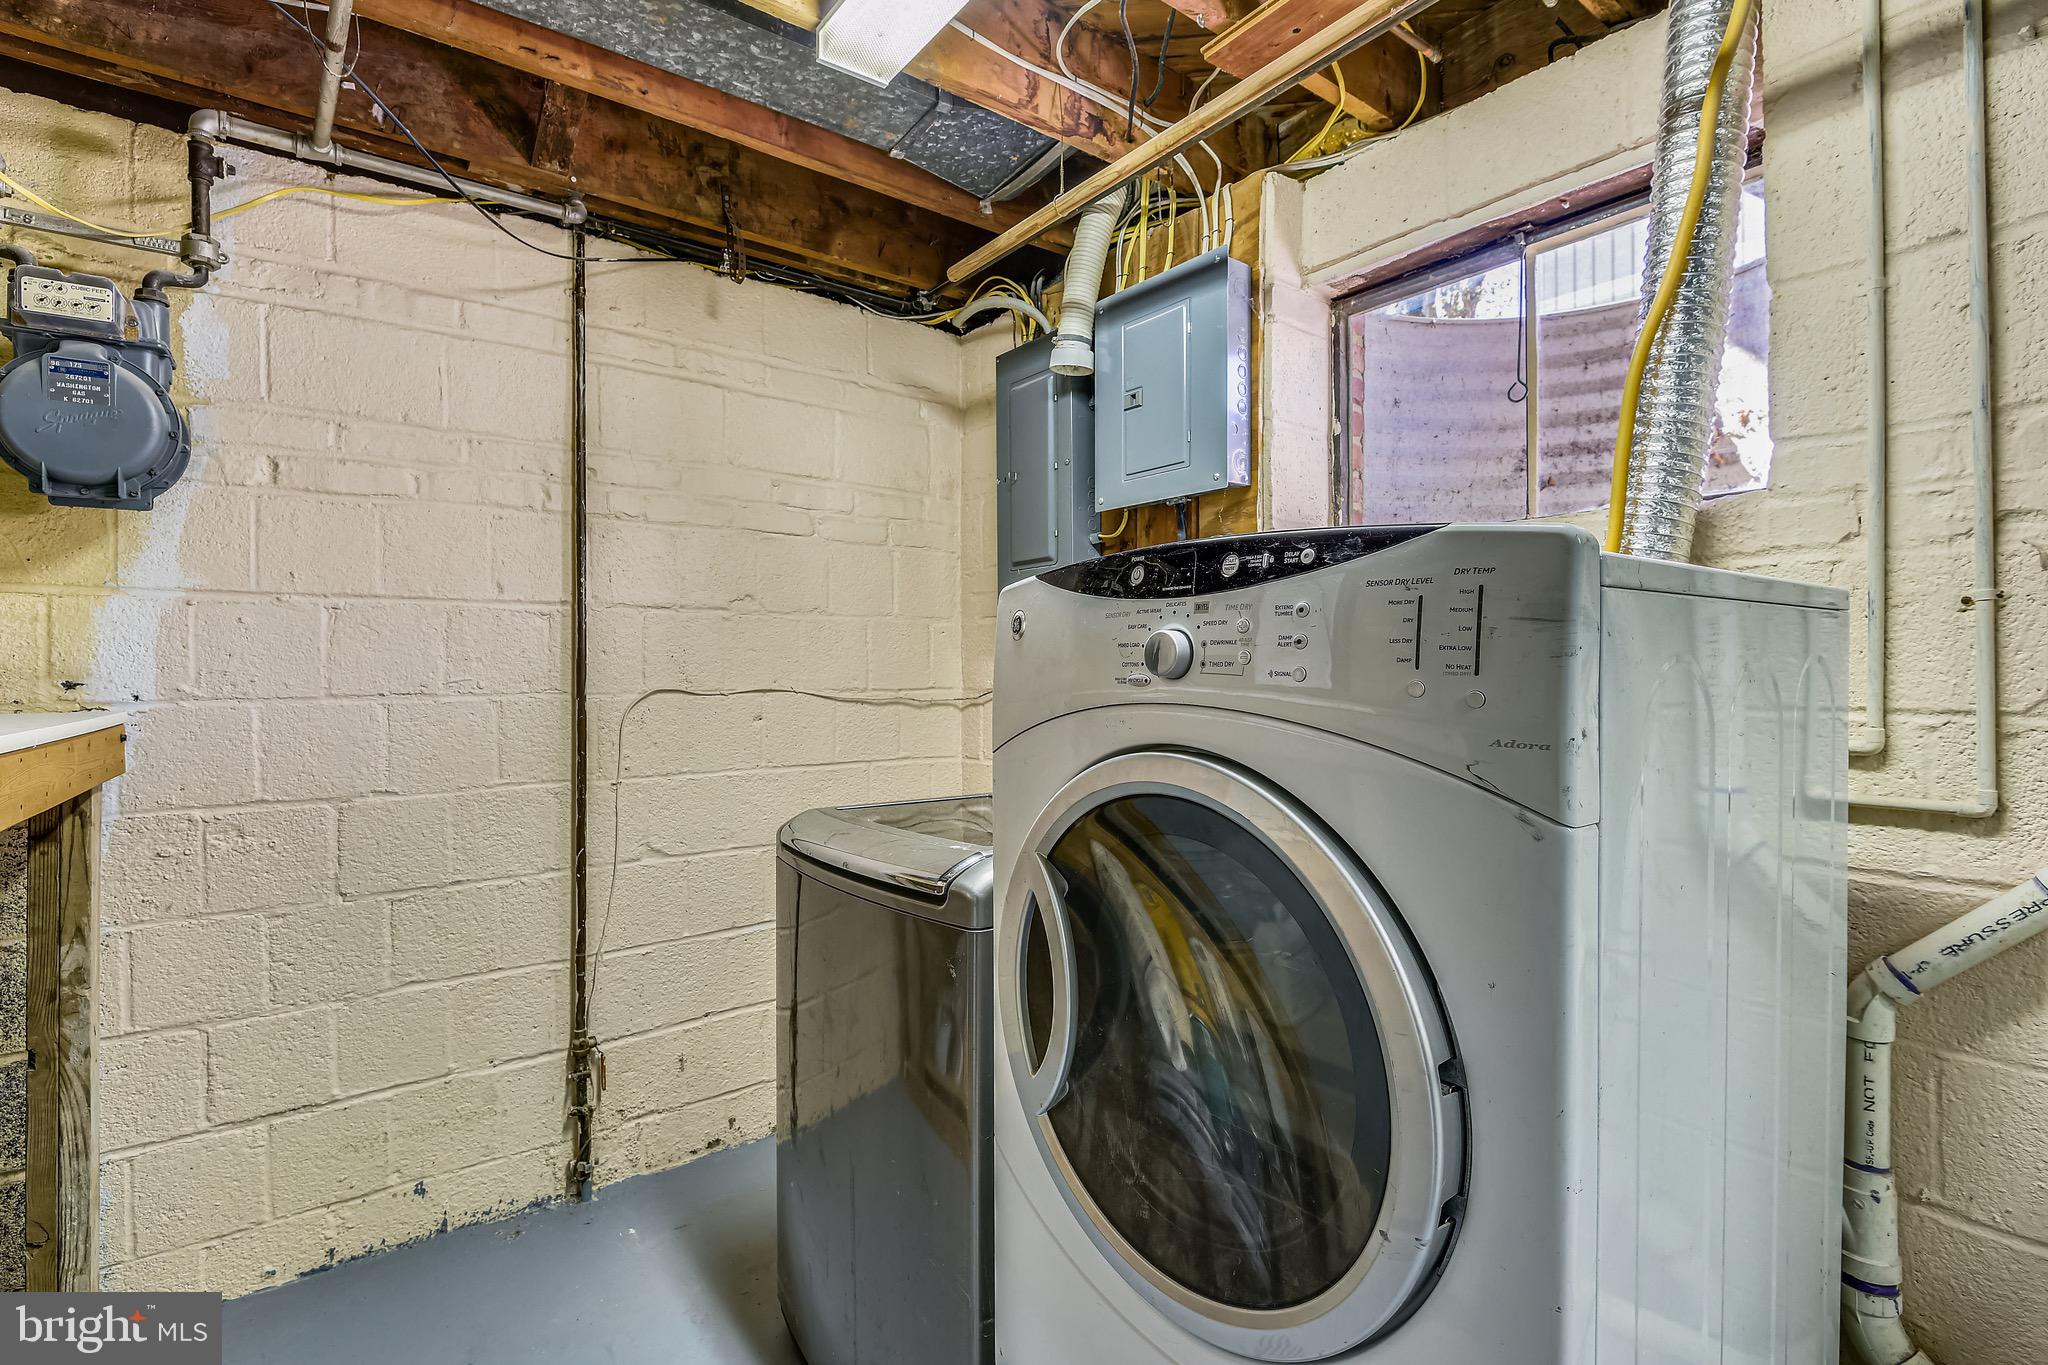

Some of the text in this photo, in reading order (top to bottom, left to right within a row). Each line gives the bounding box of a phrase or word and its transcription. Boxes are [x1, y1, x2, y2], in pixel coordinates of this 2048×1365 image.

[56, 381, 101, 391] WASHINGTON
[1472, 567, 1496, 575] TEMP
[1394, 578, 1411, 586] DRY
[1411, 577, 1434, 585] LEVEL
[1240, 603, 1253, 611] DRY
[1488, 738, 1552, 751] Adora
[1863, 1075, 1876, 1113] NOT
